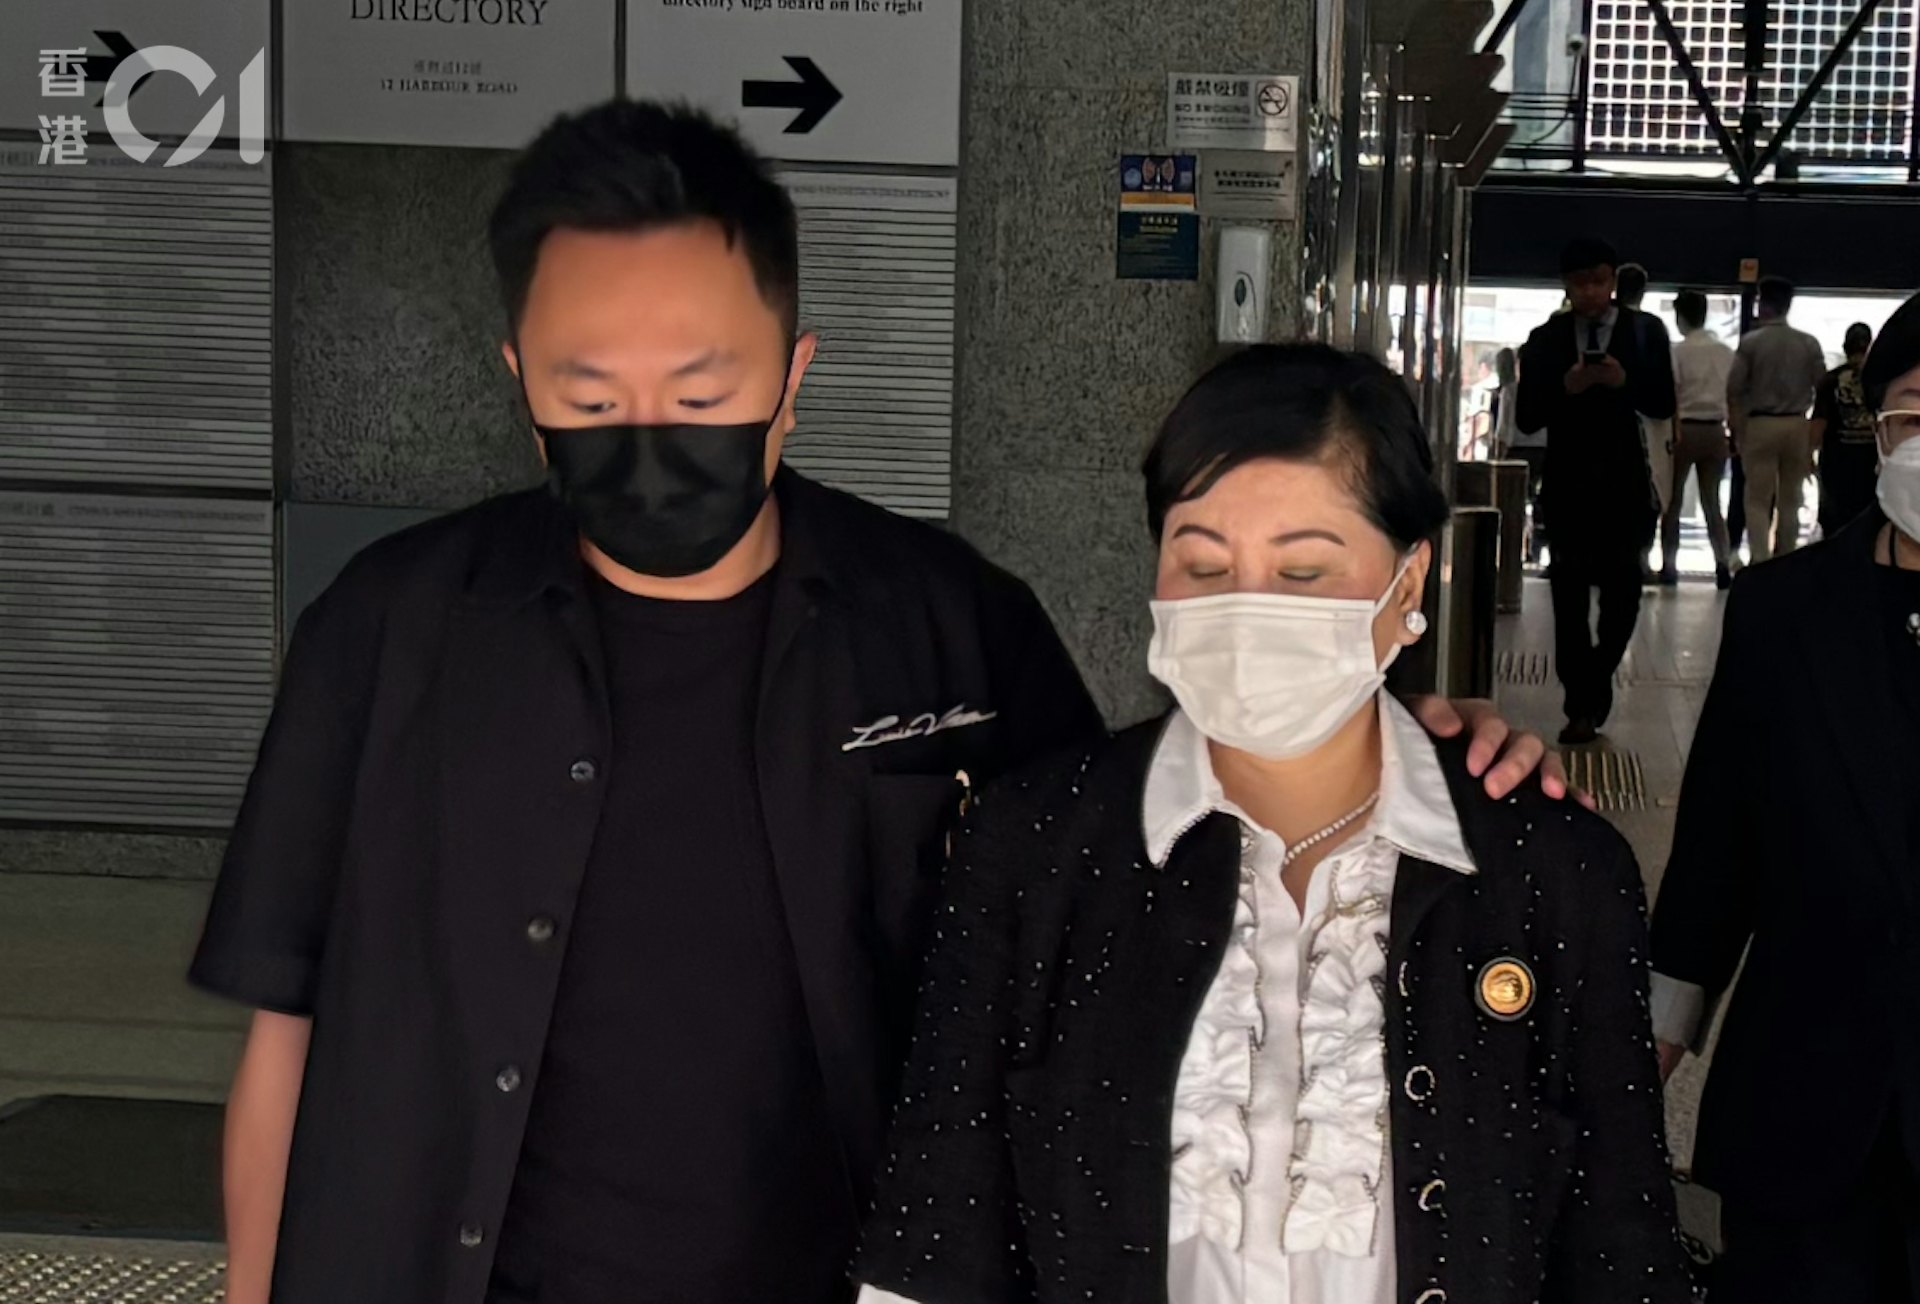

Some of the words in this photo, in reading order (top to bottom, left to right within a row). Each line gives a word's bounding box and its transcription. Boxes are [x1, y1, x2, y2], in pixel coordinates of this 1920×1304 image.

[351, 0, 547, 25] DIRECTORY
[830, 0, 849, 11] on
[856, 0, 880, 12] the
[885, 0, 923, 15] right
